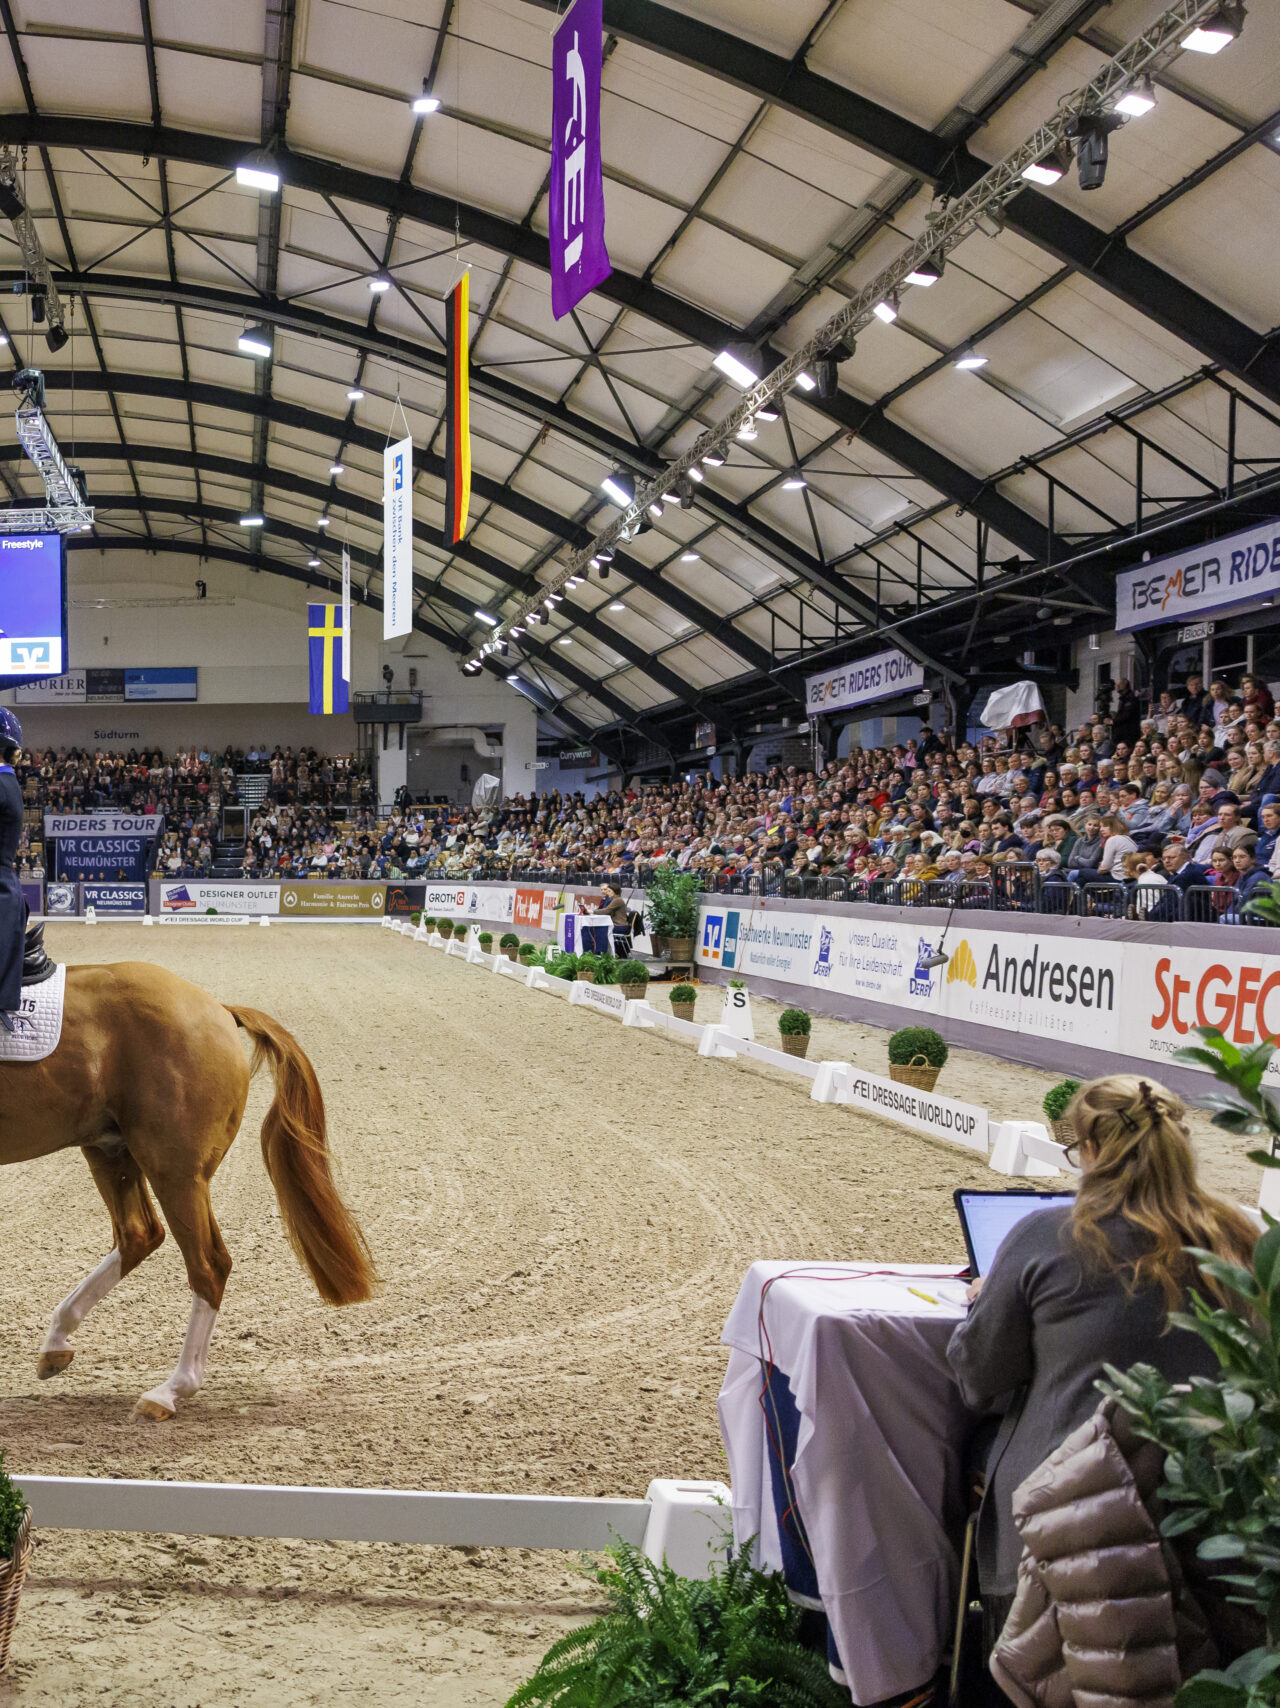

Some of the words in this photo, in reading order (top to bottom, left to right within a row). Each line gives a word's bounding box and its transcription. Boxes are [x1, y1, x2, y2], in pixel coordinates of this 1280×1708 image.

[3, 539, 43, 551] Freestyle
[1132, 557, 1221, 612] BEMER
[1184, 625, 1207, 639] Block
[848, 664, 882, 694] RIDERS
[884, 657, 913, 683] TOUR
[94, 729, 140, 739] Südturm
[52, 819, 107, 832] RIDERS
[112, 819, 156, 831] TOUR
[60, 840, 76, 852] VR
[81, 840, 140, 853] CLASSICS
[65, 855, 136, 867] NEUMÜNSTER
[85, 891, 98, 899] VR
[100, 890, 143, 900] CLASSICS
[200, 890, 245, 898] DESIGNER
[247, 891, 278, 899] OUTLET
[428, 893, 456, 903] GROTH
[473, 927, 479, 935] V
[739, 922, 771, 944] Stadtwerke
[773, 925, 812, 950] Neumünster
[848, 928, 870, 947] Unsere
[872, 932, 898, 951] Qualität
[849, 953, 861, 970] Ihre
[982, 943, 1115, 1011] Andresen
[22, 999, 36, 1012] 15
[733, 991, 746, 1008] S
[872, 1084, 917, 1118] DRESSAGE
[919, 1100, 953, 1129] WORLD
[955, 1112, 976, 1136] CUP
